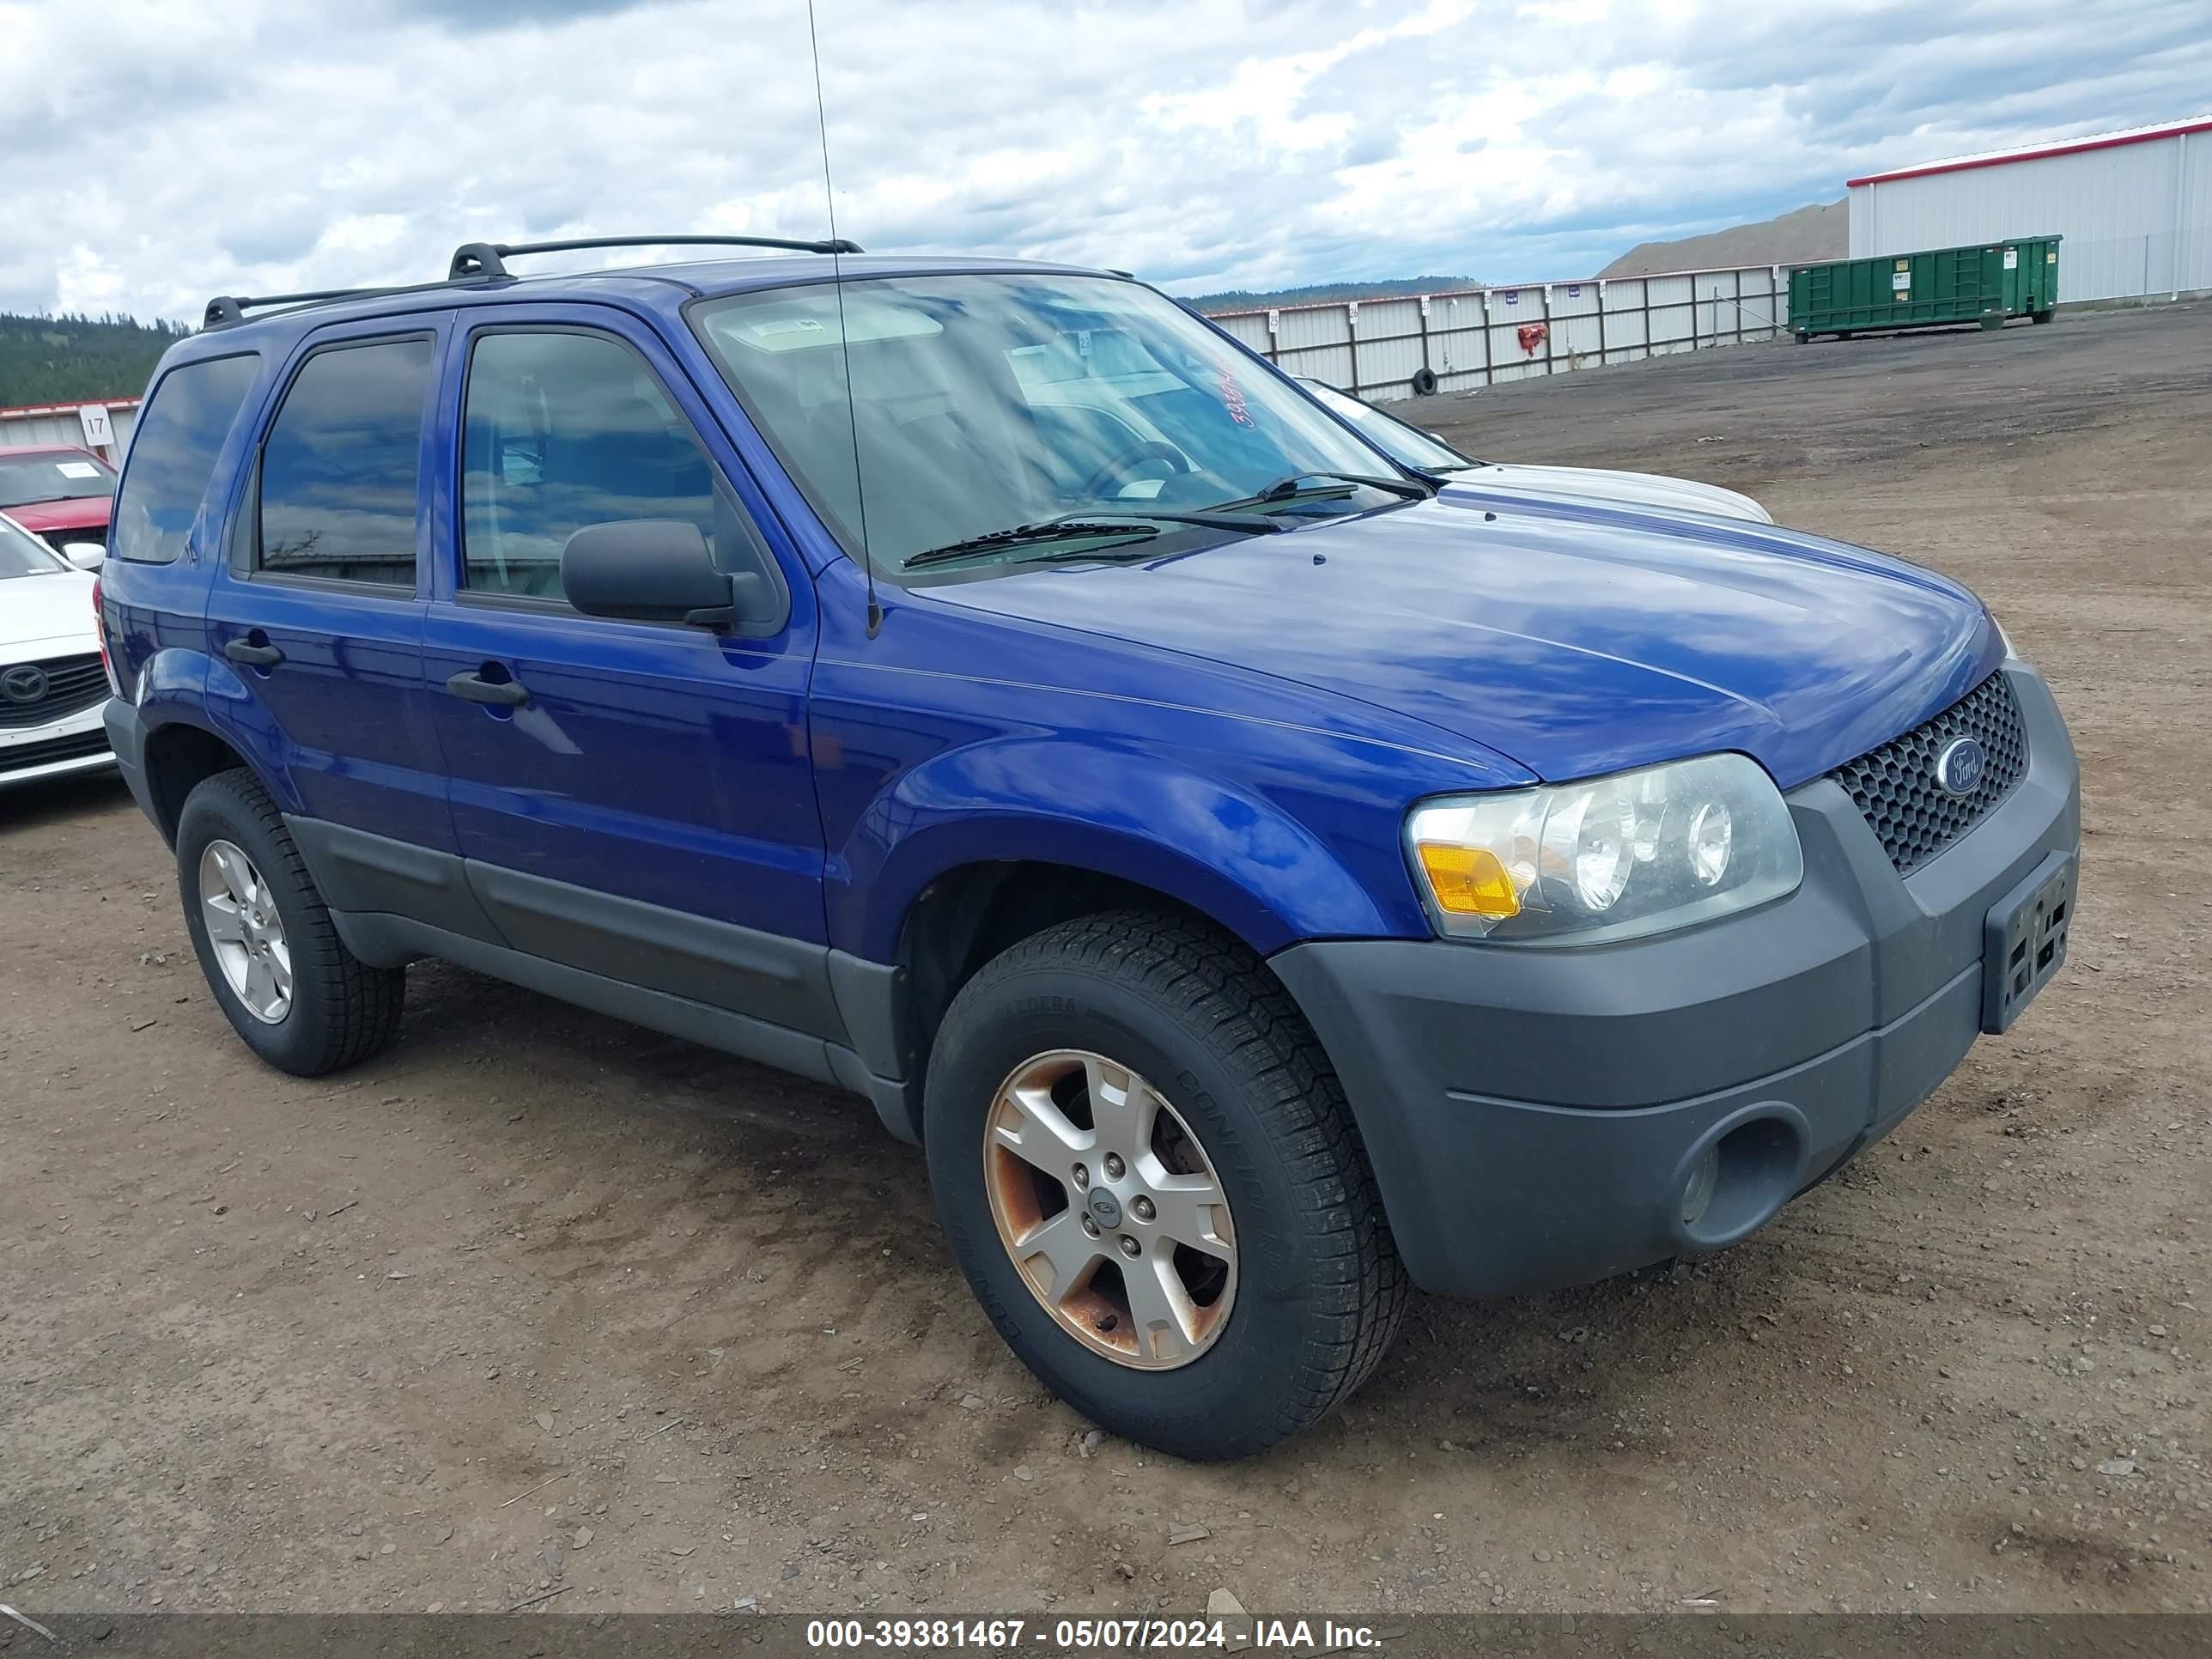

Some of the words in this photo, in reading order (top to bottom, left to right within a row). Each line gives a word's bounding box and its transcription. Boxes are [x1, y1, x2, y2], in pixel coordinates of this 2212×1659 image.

[1270, 315, 1279, 326] 25
[88, 417, 104, 435] 17
[1953, 748, 1979, 786] Ford
